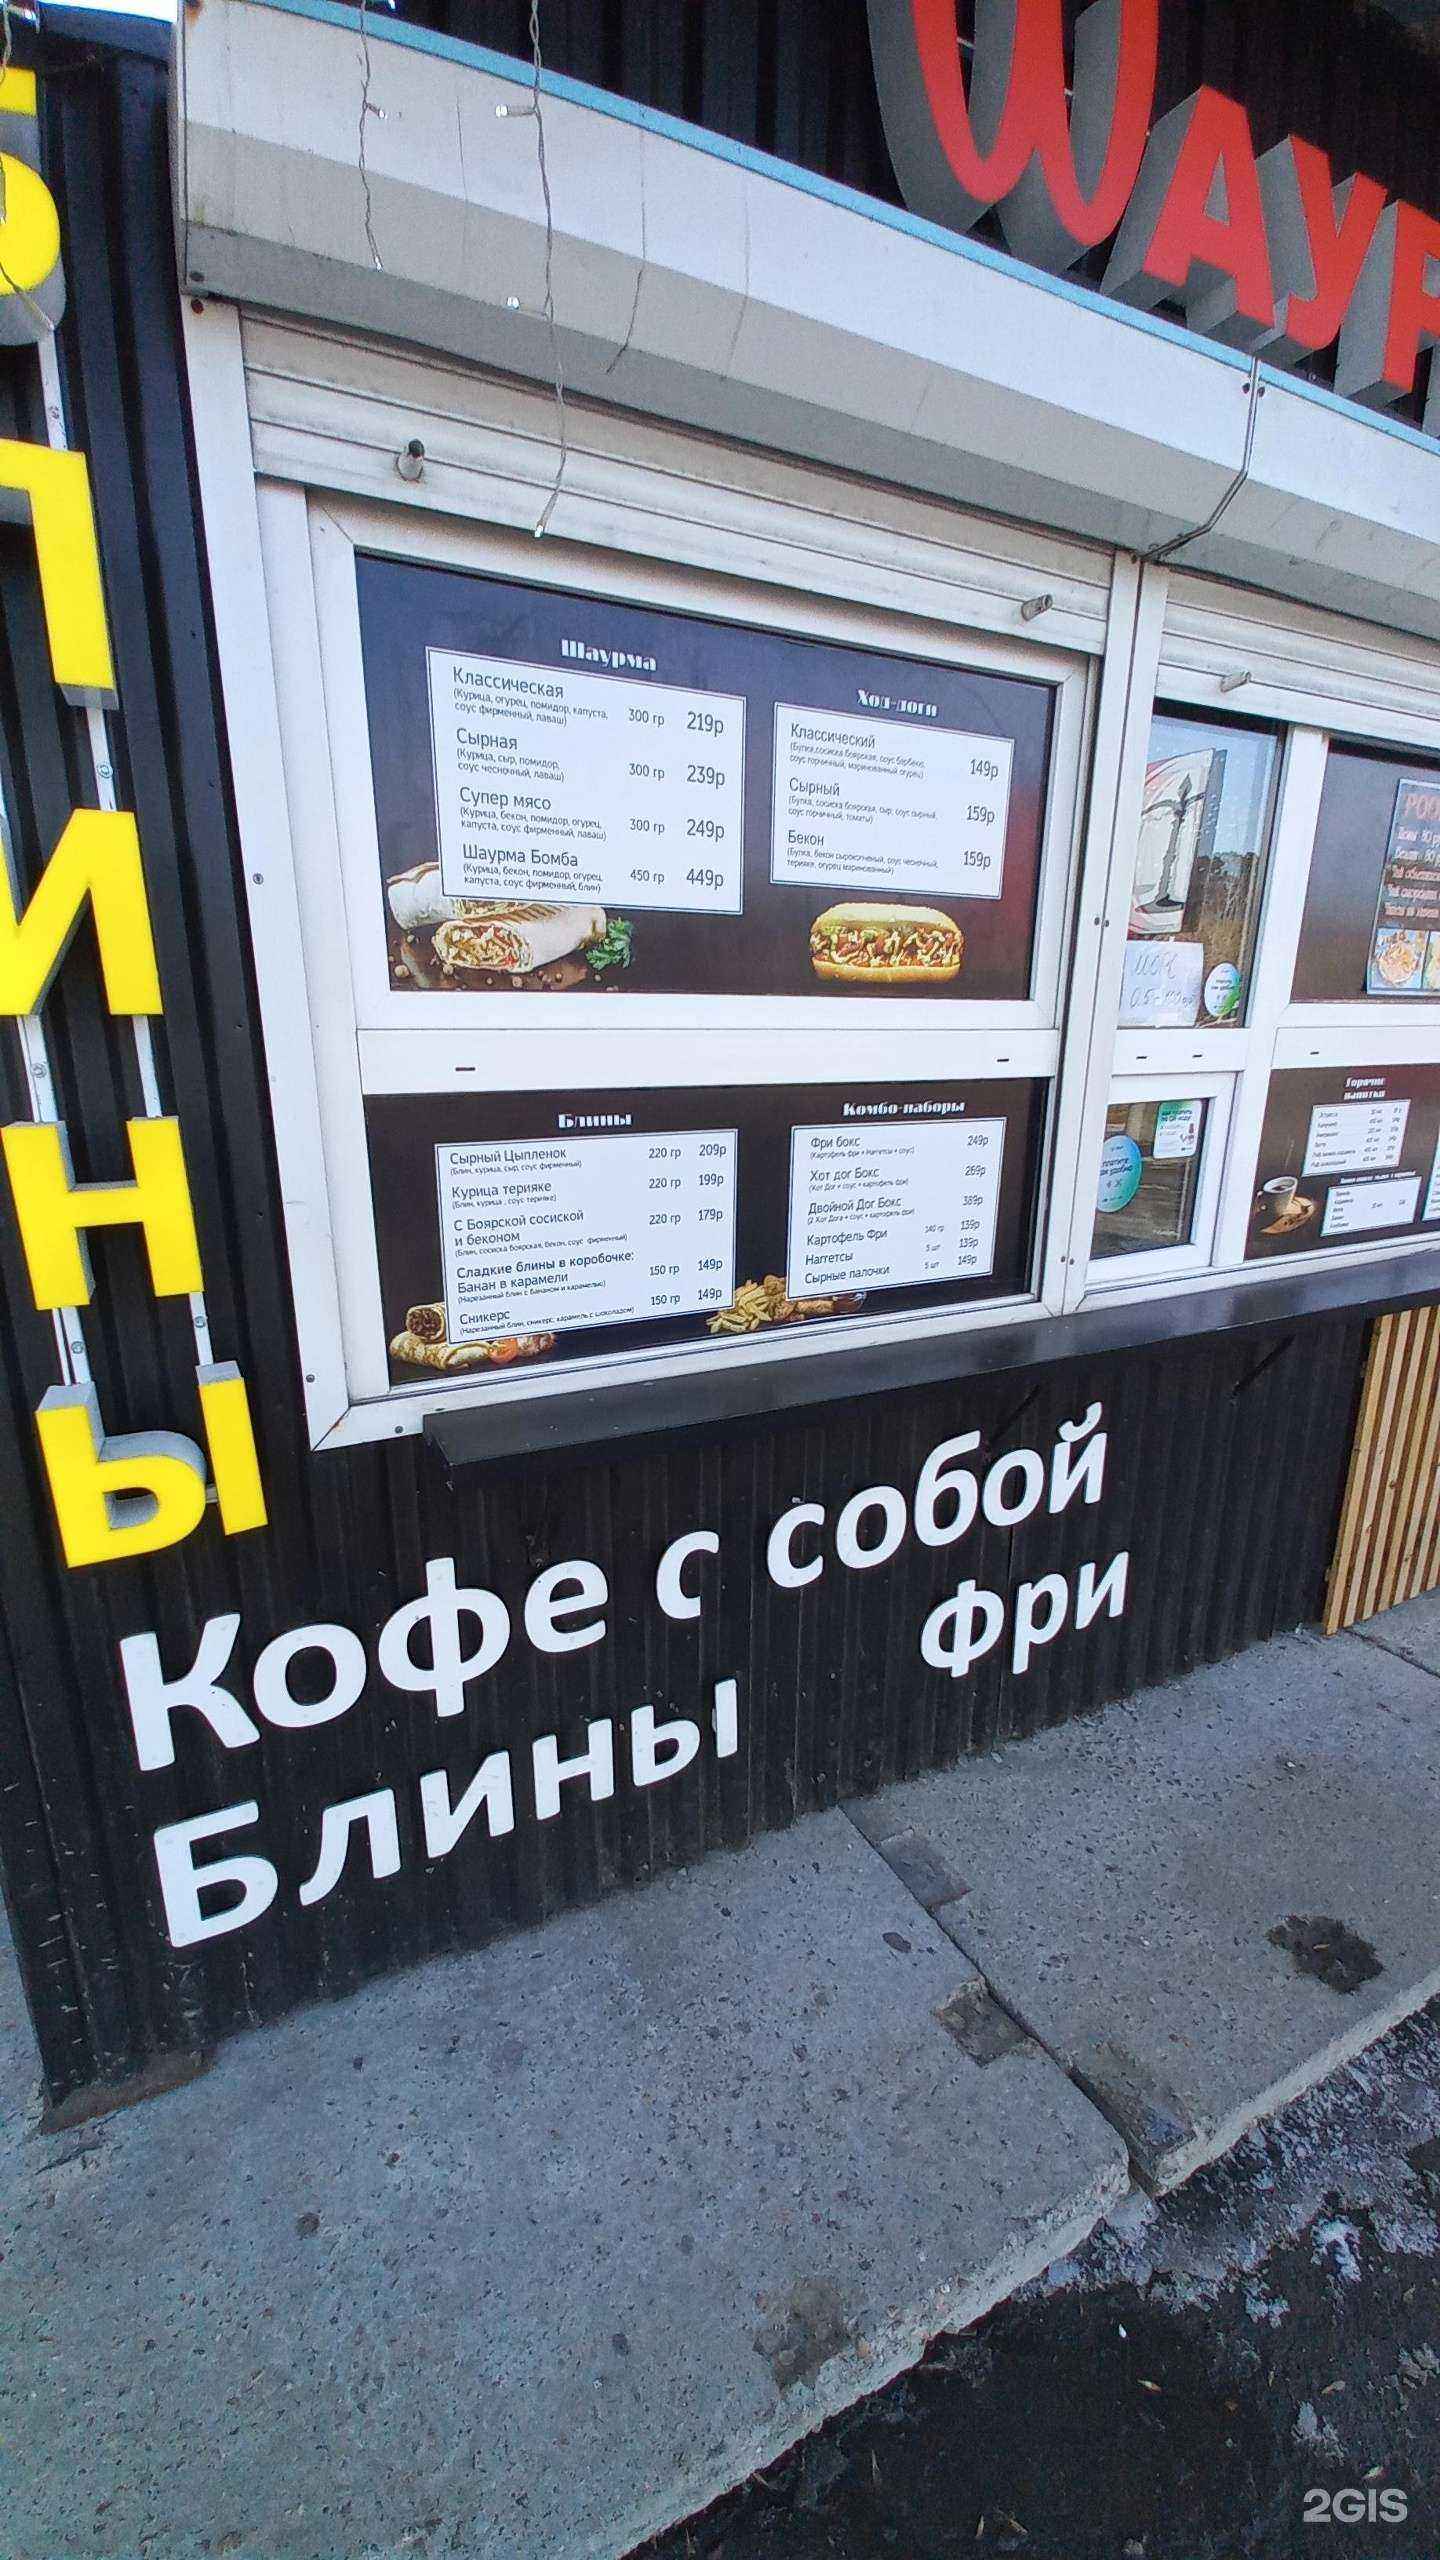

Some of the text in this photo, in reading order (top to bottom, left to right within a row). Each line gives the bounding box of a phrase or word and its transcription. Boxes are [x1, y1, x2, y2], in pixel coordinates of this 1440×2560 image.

[561, 639, 656, 671] Шаурма
[453, 666, 564, 698] Классическая
[455, 701, 476, 715] соус
[536, 713, 566, 727] лаваш)
[629, 708, 724, 737] 300 гр 219р
[456, 728, 518, 750] Сырная
[791, 722, 998, 780] Классический 149р
[458, 761, 479, 774] соус
[534, 770, 564, 782] лаваш)
[629, 763, 726, 790] 300 гр 239р
[460, 786, 551, 810] Супер мясо
[789, 778, 995, 826] Сырный 159р
[501, 824, 521, 834] соус
[578, 830, 606, 842] лаваш)
[630, 818, 724, 843] 300 гр 249р
[462, 843, 578, 867] Шаурма Бомба
[788, 830, 991, 870] Бекон 159р
[504, 879, 524, 889] соус
[630, 868, 724, 890] 450 гр 449р
[558, 1114, 632, 1128] Блины
[842, 1100, 965, 1118] Комбо-наборы
[810, 1138, 833, 1150] Фри
[967, 1134, 989, 1148] 249р
[450, 1144, 726, 1166] Сырный Цыпленок 220 гр 209р
[810, 1170, 830, 1182] Хот
[834, 1169, 852, 1182] дог
[855, 1166, 880, 1179] Бокс
[452, 1173, 724, 1200] Курица терияке 220 гр 199р
[808, 1196, 902, 1216] Двойной Дог Бокс
[454, 1208, 724, 1231] С Боярской сосиской 220 гр 179р
[454, 1231, 520, 1247] и беконом
[806, 1230, 865, 1249] Картофель
[866, 1228, 888, 1242] Фри
[456, 1251, 634, 1279] Сладкие блины в коробочке:
[805, 1250, 854, 1266] Наггетсы
[458, 1259, 723, 1294] Банан в карамели 150 гр 149р
[804, 1270, 847, 1285] Сырные
[849, 1266, 890, 1281] палочки
[459, 1288, 722, 1326] Сникерс 150 гр 149р
[120, 1401, 1108, 1772] Кофе с собой
[920, 1551, 1130, 1679] Фри
[153, 1678, 738, 1948] Блины
